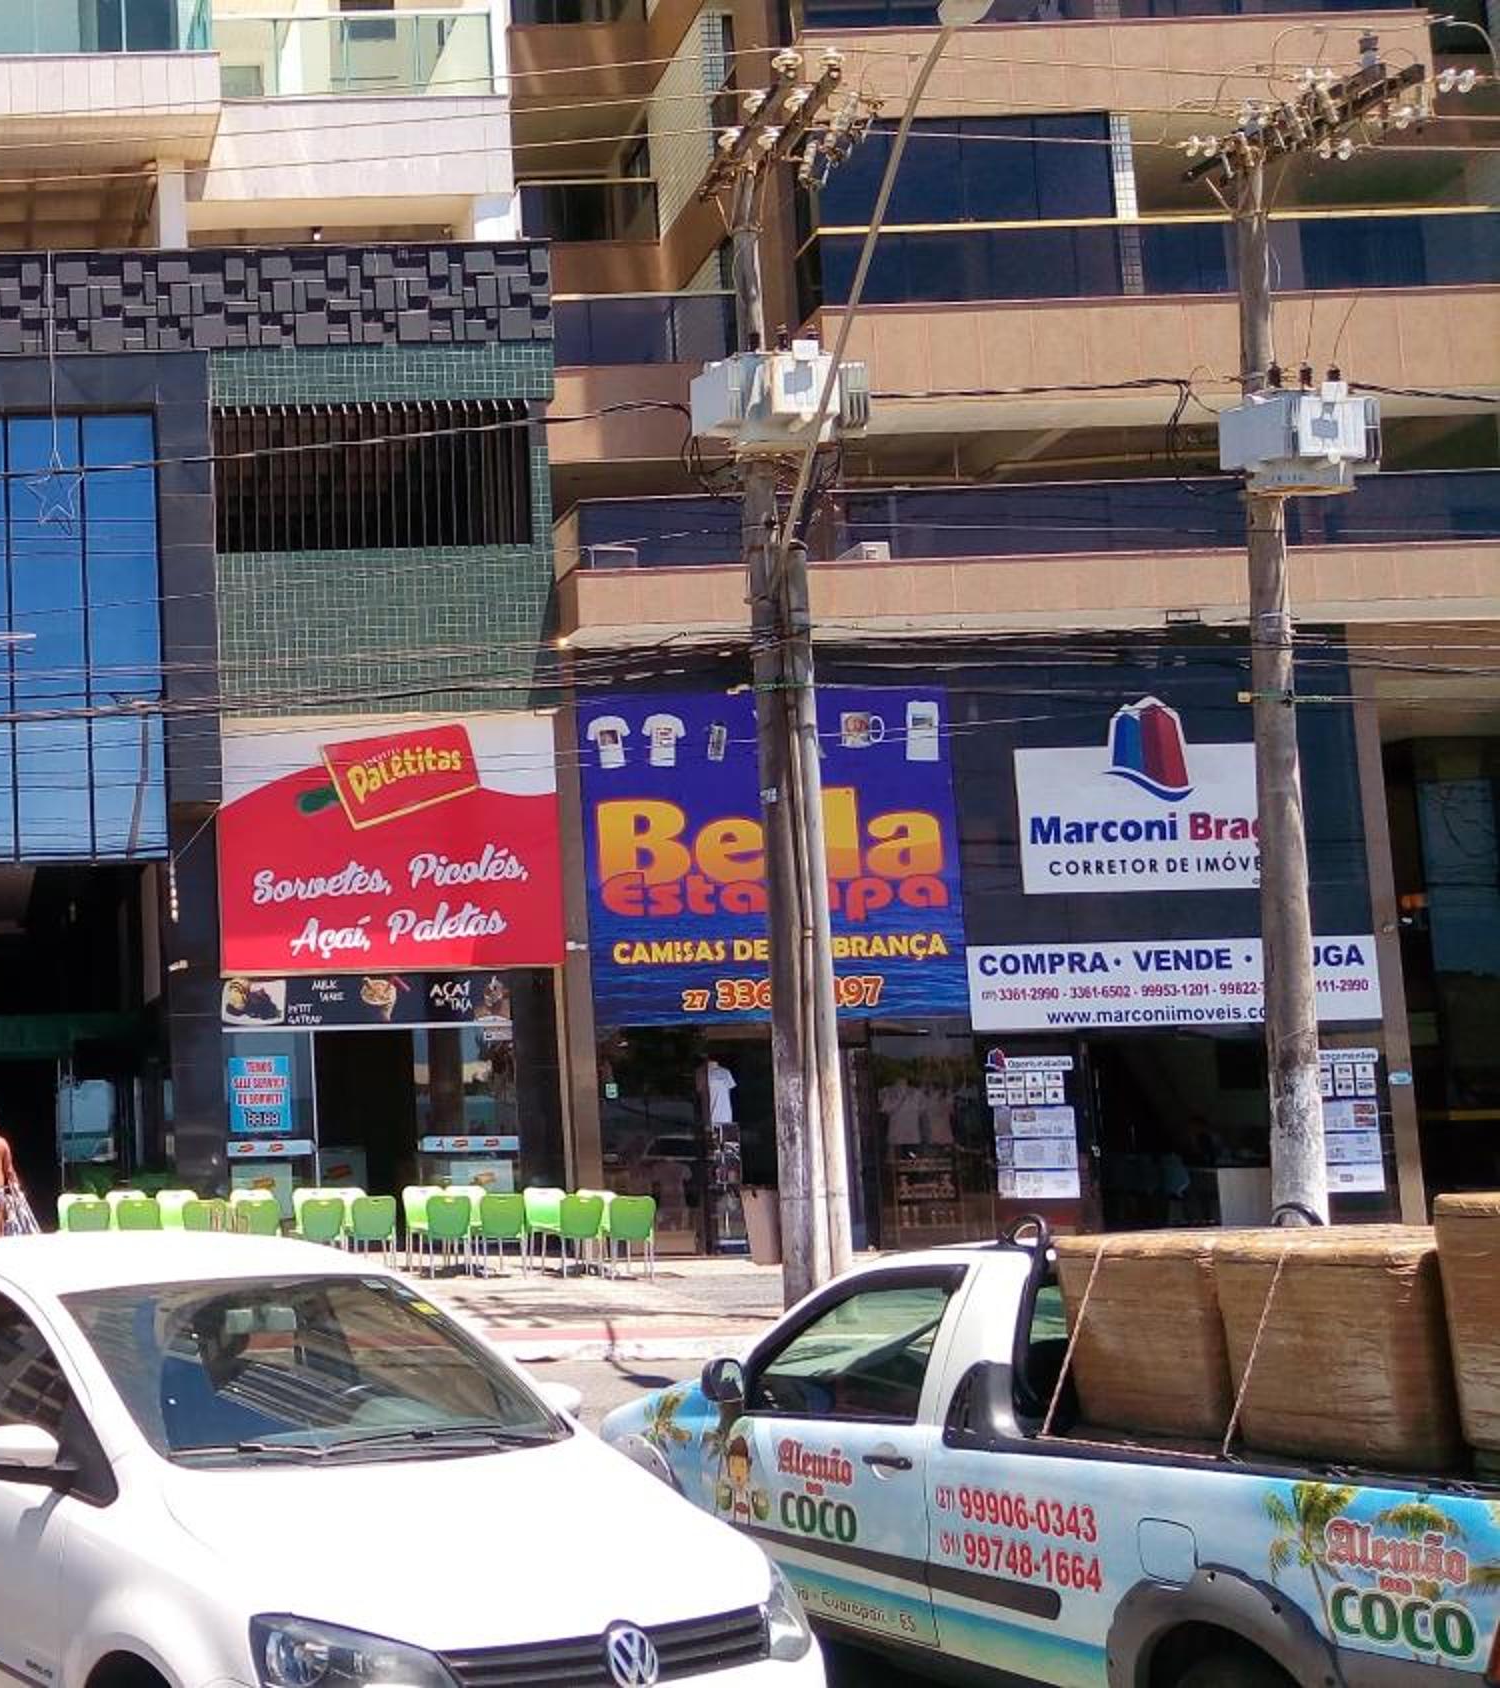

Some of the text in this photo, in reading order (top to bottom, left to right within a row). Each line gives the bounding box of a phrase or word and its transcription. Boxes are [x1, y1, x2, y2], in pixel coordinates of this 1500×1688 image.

[597, 786, 943, 888] Bela
[1030, 812, 1260, 848] Marconi Bra
[409, 844, 528, 888] Picolés,
[1049, 851, 1261, 876] CORRETOR DE IMÓVE
[602, 870, 948, 921] Estapa
[388, 902, 507, 944] Paletas
[613, 932, 948, 964] CAMISAS DE BRANÇA
[979, 951, 1109, 976] COMPRA
[1133, 948, 1232, 971] VENDE
[683, 989, 709, 1010] 27
[1219, 980, 1265, 997] 99822-
[1316, 978, 1369, 993] 111-2990
[1047, 1004, 1267, 1023] www.marconiimoveis.co
[780, 1490, 857, 1543] COCO
[959, 1486, 1098, 1543] 99906-0343
[963, 1533, 1103, 1593] 99748-1664
[1327, 1517, 1468, 1585] Alemão
[1330, 1586, 1477, 1658] COCO
